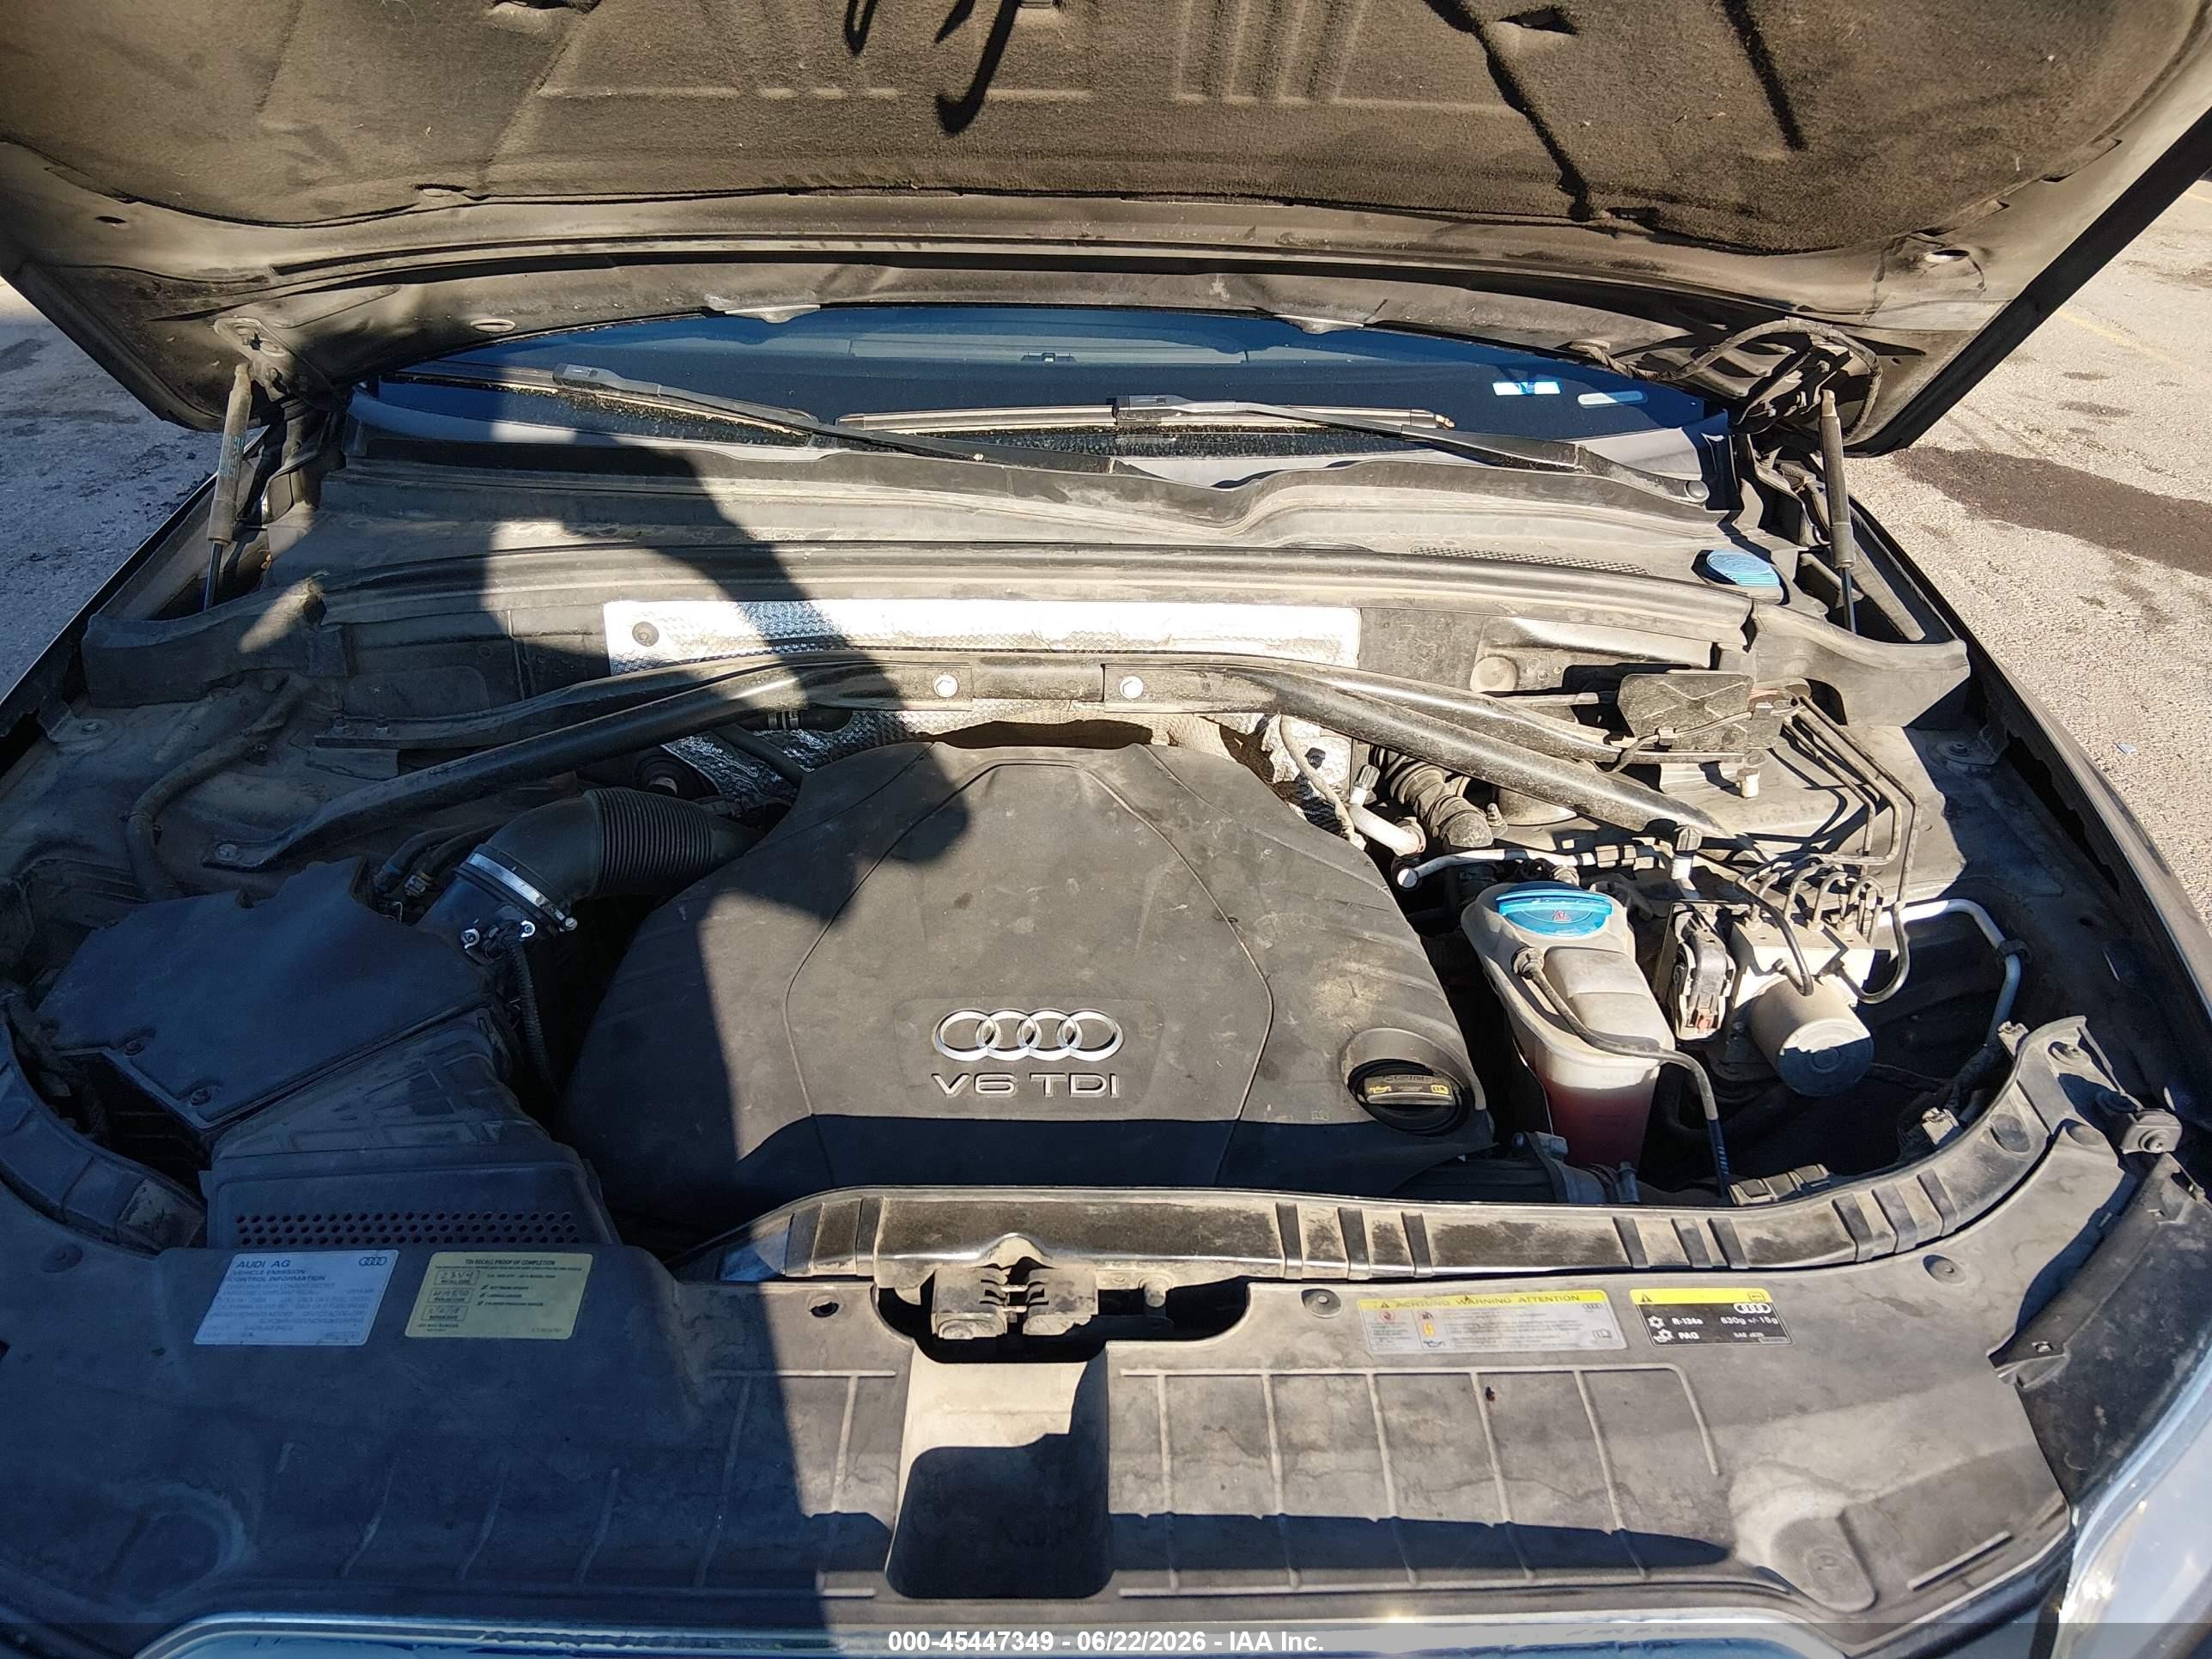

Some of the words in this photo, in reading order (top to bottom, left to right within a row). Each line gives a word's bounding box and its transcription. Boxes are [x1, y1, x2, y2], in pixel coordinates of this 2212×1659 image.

[932, 1072, 1017, 1098] V6
[1030, 1072, 1120, 1099] TDI
[236, 1260, 266, 1268] AUDI
[270, 1260, 291, 1268] AG
[1395, 1299, 1450, 1308] ACHTUNG
[1455, 1296, 1512, 1305] WARNING
[1518, 1294, 1580, 1303] ATTENTION
[1671, 1316, 1704, 1326] R-134a
